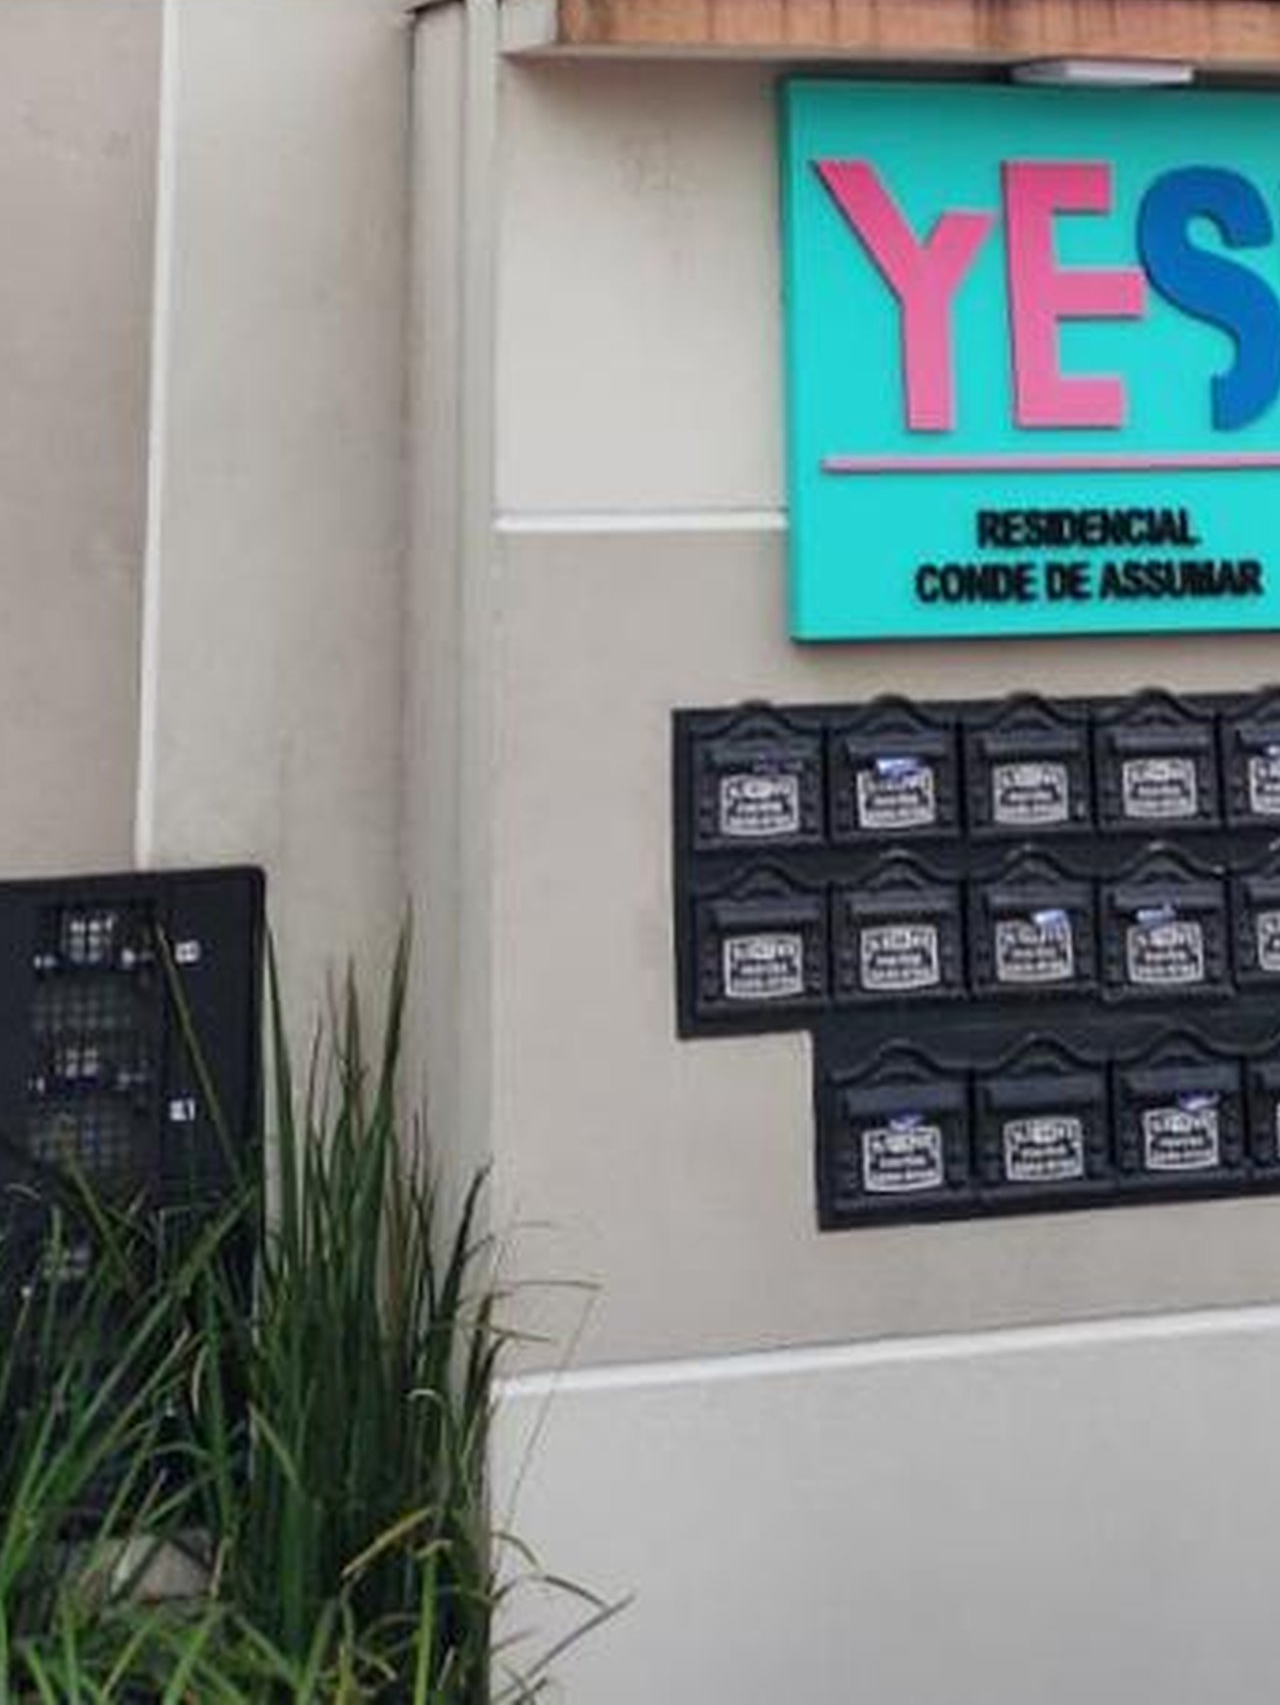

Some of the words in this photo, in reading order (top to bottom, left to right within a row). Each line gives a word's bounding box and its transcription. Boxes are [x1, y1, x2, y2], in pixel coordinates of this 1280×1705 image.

[977, 508, 1201, 549] RESIDENCIAL
[915, 561, 1037, 604] CONDE
[1044, 561, 1093, 602] DE
[1099, 559, 1264, 601] ASSUMAR
